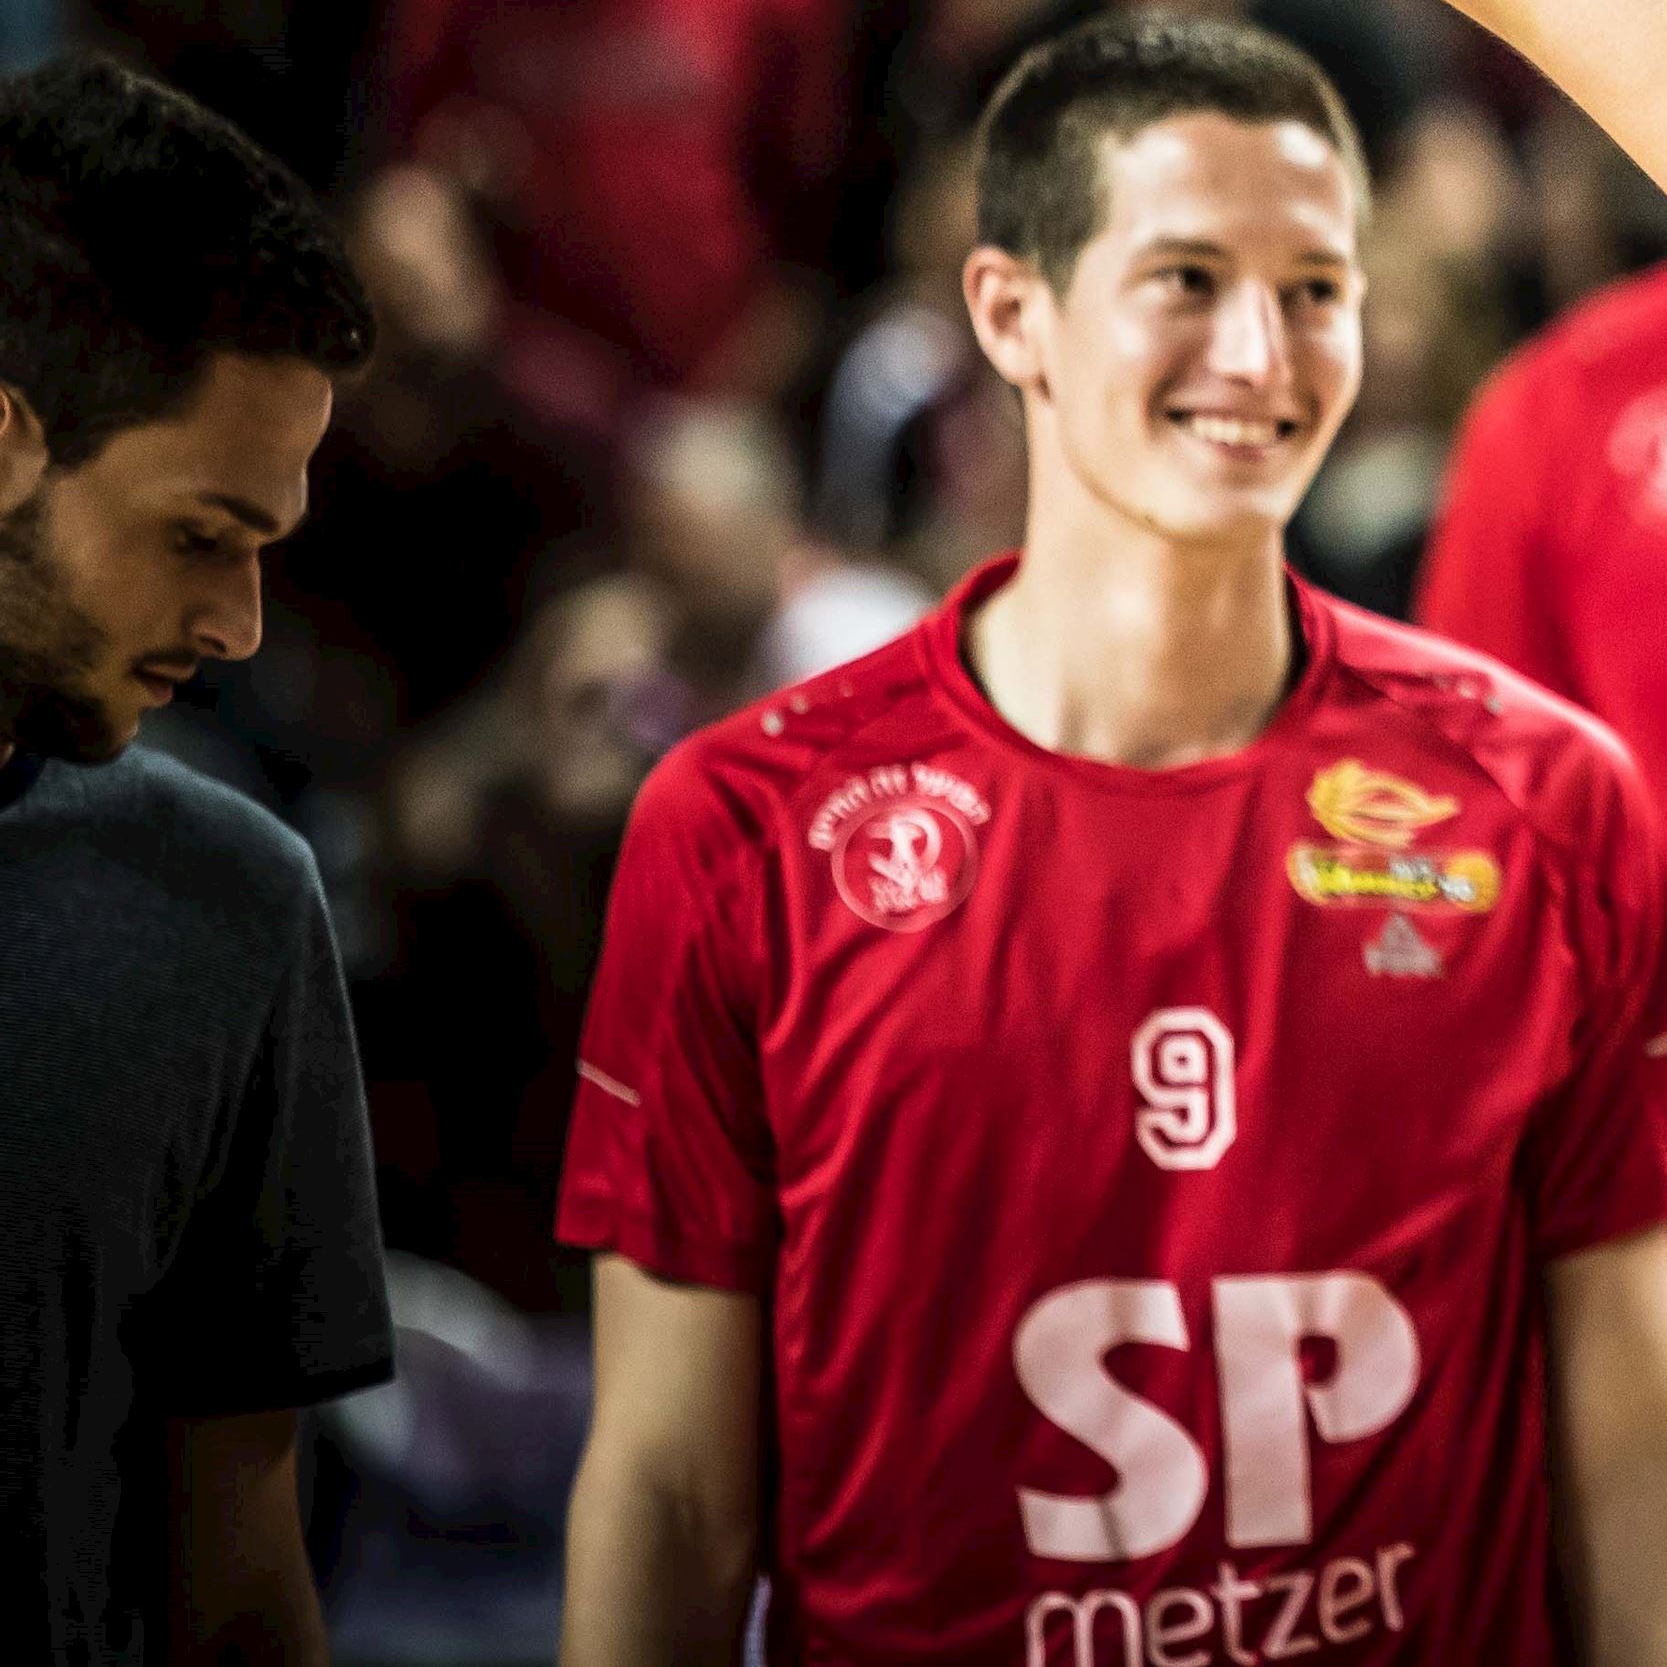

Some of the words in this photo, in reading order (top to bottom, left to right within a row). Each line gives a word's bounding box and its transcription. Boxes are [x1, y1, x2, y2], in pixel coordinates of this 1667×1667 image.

[1131, 1006, 1237, 1172] 9
[1012, 1269, 1422, 1563] SP
[1025, 1542, 1417, 1667] metzer
